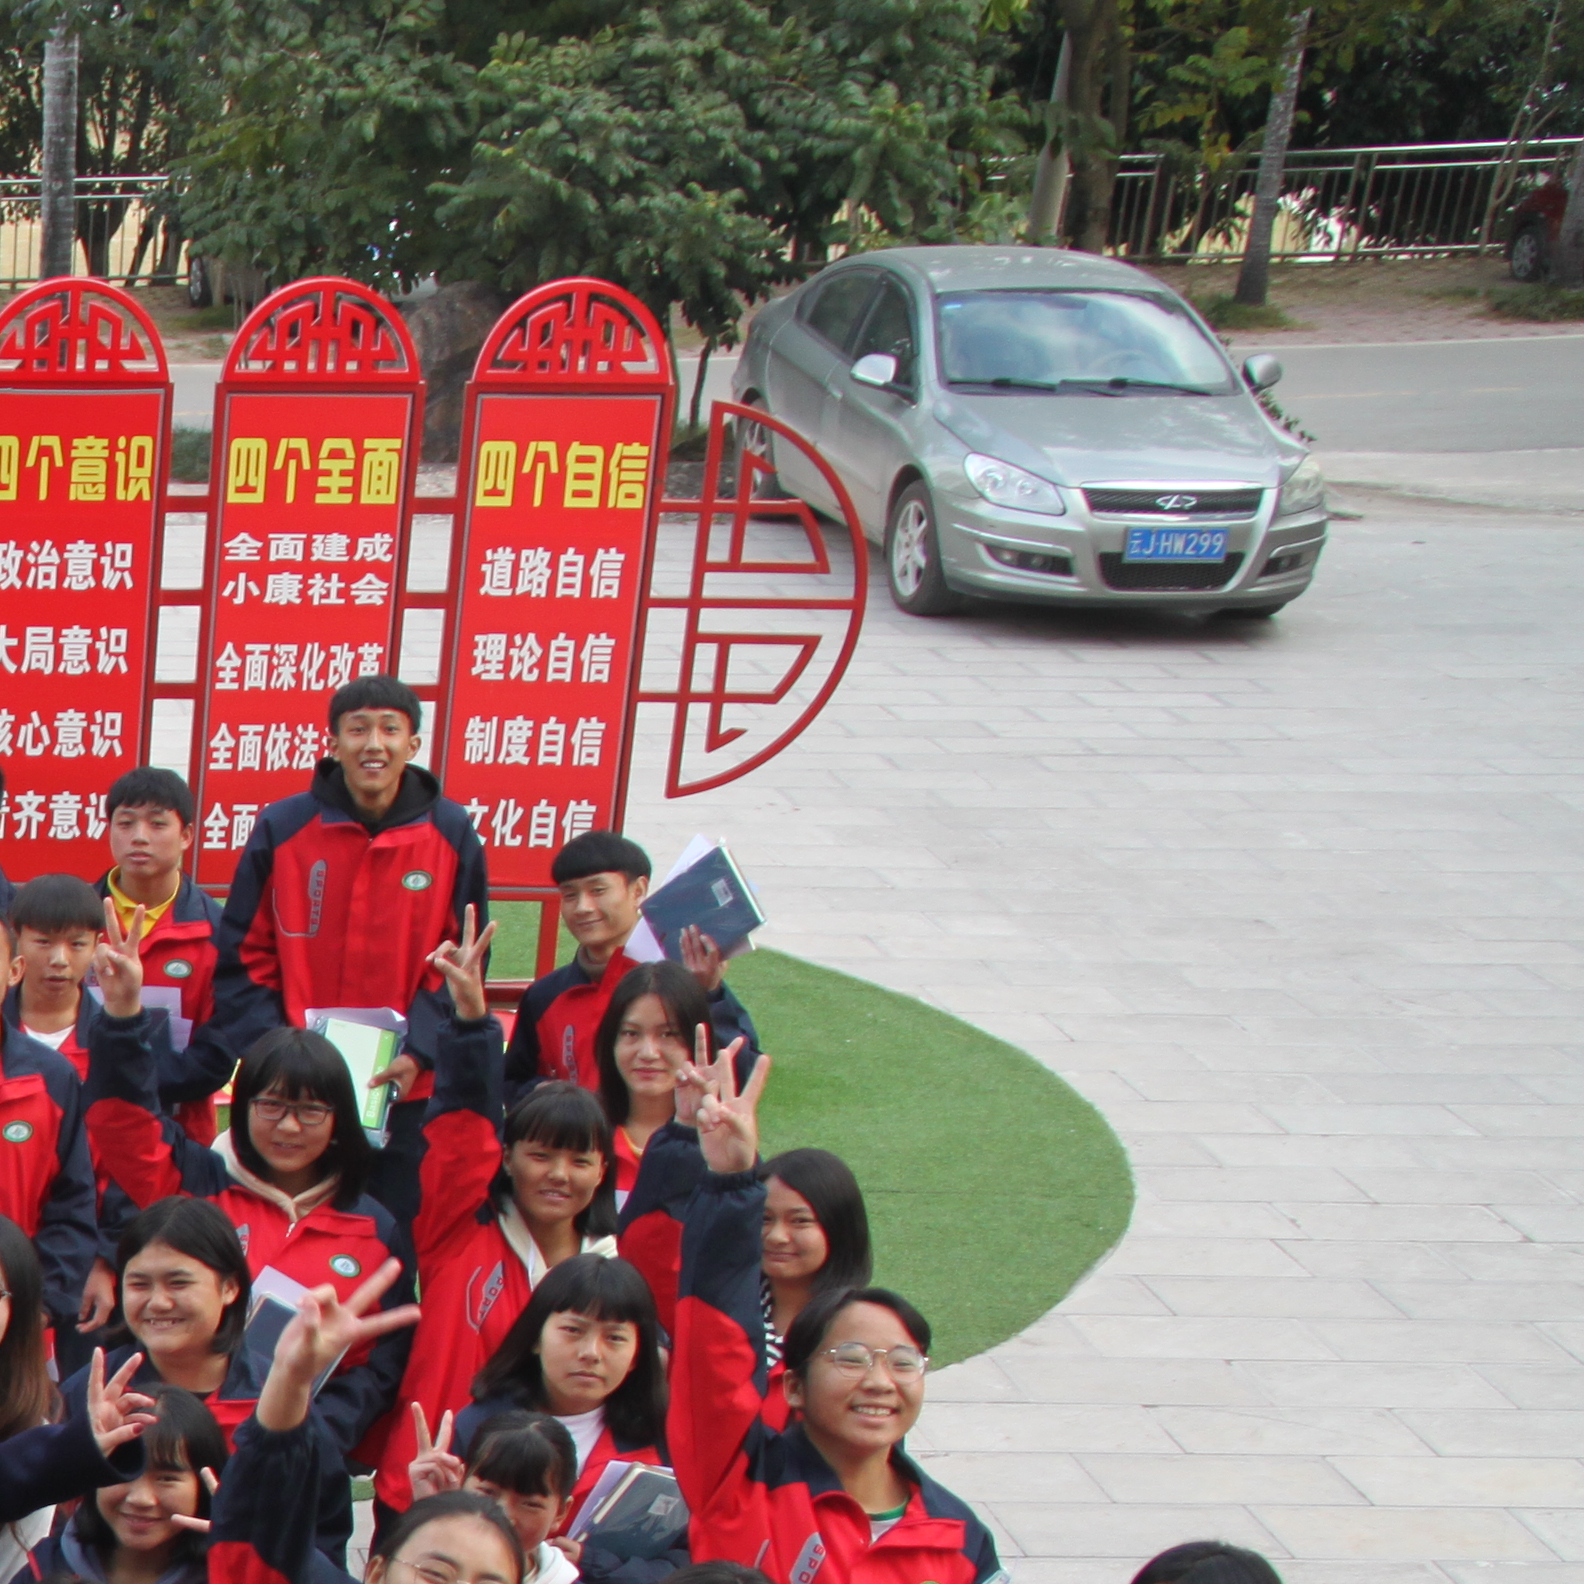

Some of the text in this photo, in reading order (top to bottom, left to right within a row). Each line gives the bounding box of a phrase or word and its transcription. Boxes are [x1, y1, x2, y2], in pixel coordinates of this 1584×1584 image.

[226, 437, 403, 505] 四个全面
[475, 440, 650, 509] 四个自信
[223, 531, 394, 562] 全面建成
[221, 571, 390, 606] 小康社会
[479, 546, 626, 599] 道路自信
[214, 641, 384, 692] 全面深化改革
[471, 632, 616, 683] 理论自信
[208, 722, 331, 772] 全面依法
[464, 715, 607, 767] 制度自信
